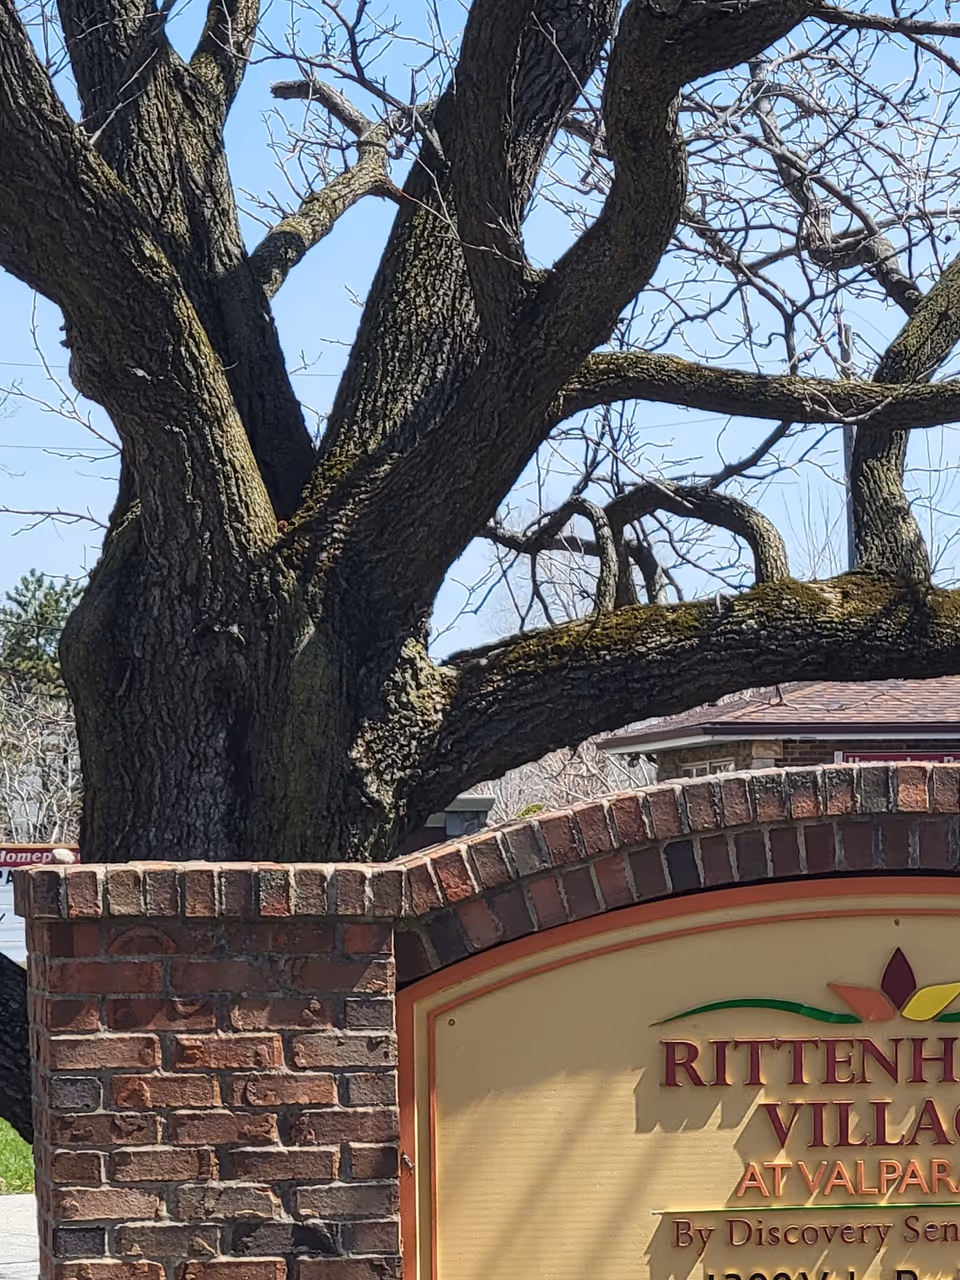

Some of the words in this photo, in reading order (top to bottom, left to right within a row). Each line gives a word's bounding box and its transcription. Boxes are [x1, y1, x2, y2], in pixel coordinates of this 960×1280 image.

[736, 1161, 793, 1197] AT
[672, 1219, 715, 1256] By
[726, 1217, 893, 1254] Discovery
